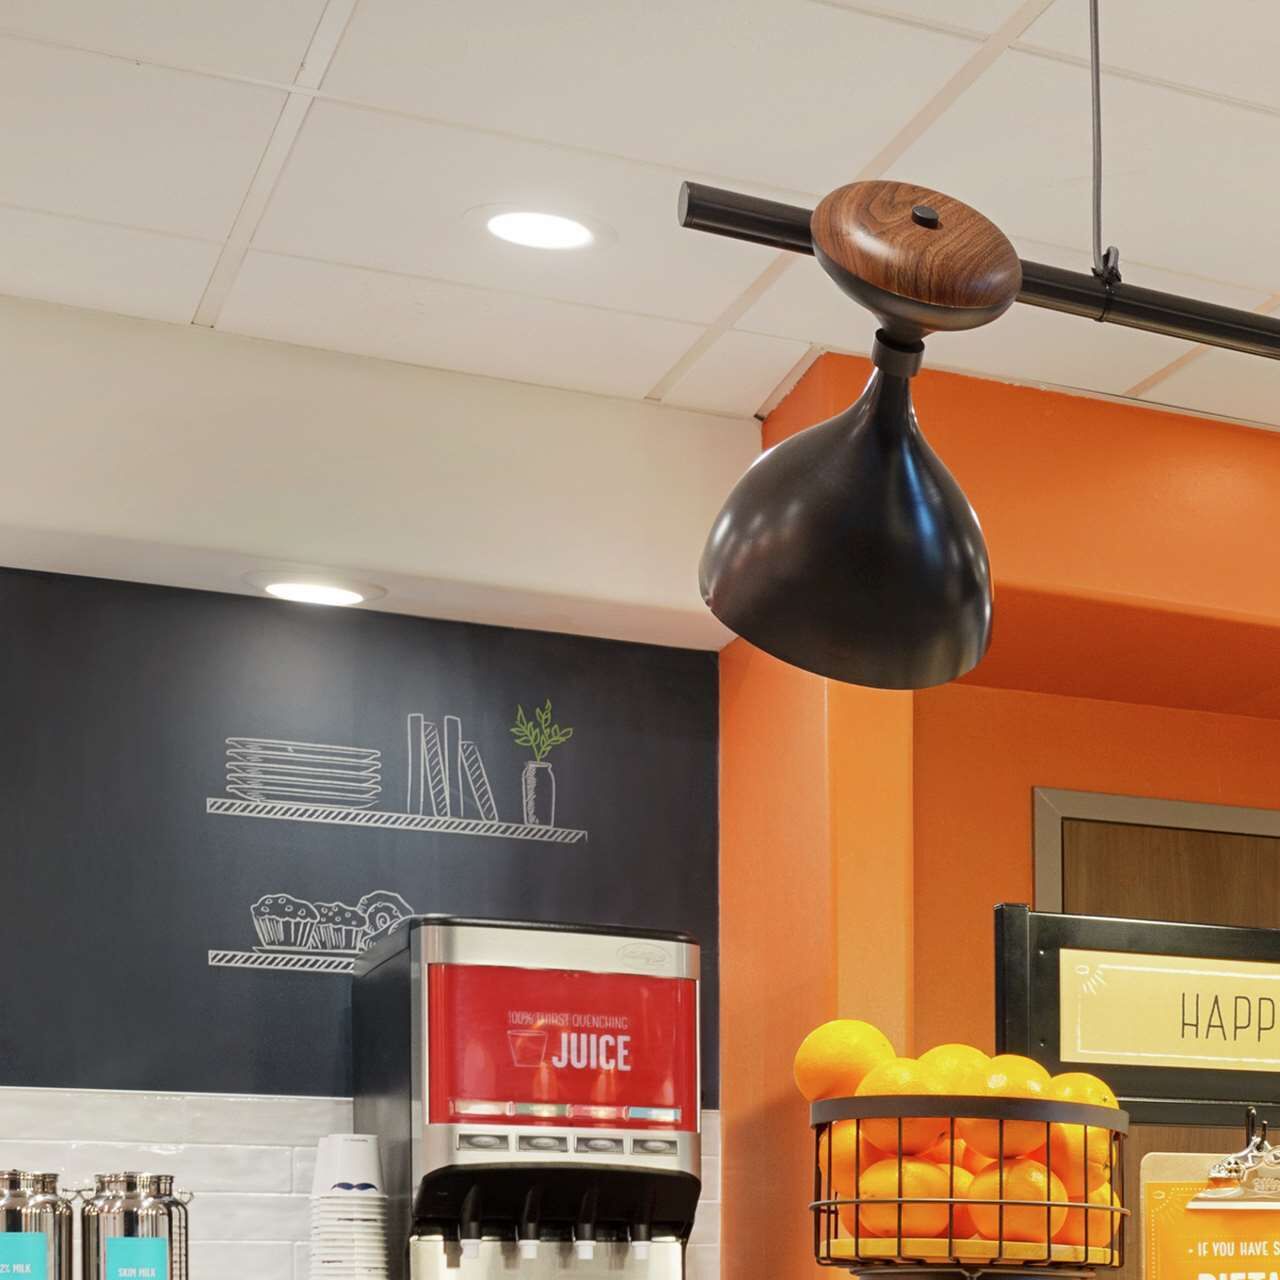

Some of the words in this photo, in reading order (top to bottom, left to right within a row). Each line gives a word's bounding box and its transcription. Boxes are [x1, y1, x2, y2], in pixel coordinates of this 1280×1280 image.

[572, 1014, 629, 1030] QUENCHING
[551, 1032, 632, 1072] JUICE
[1197, 1242, 1209, 1257] IF
[1212, 1241, 1235, 1257] YOU
[1240, 1241, 1269, 1256] HAVE
